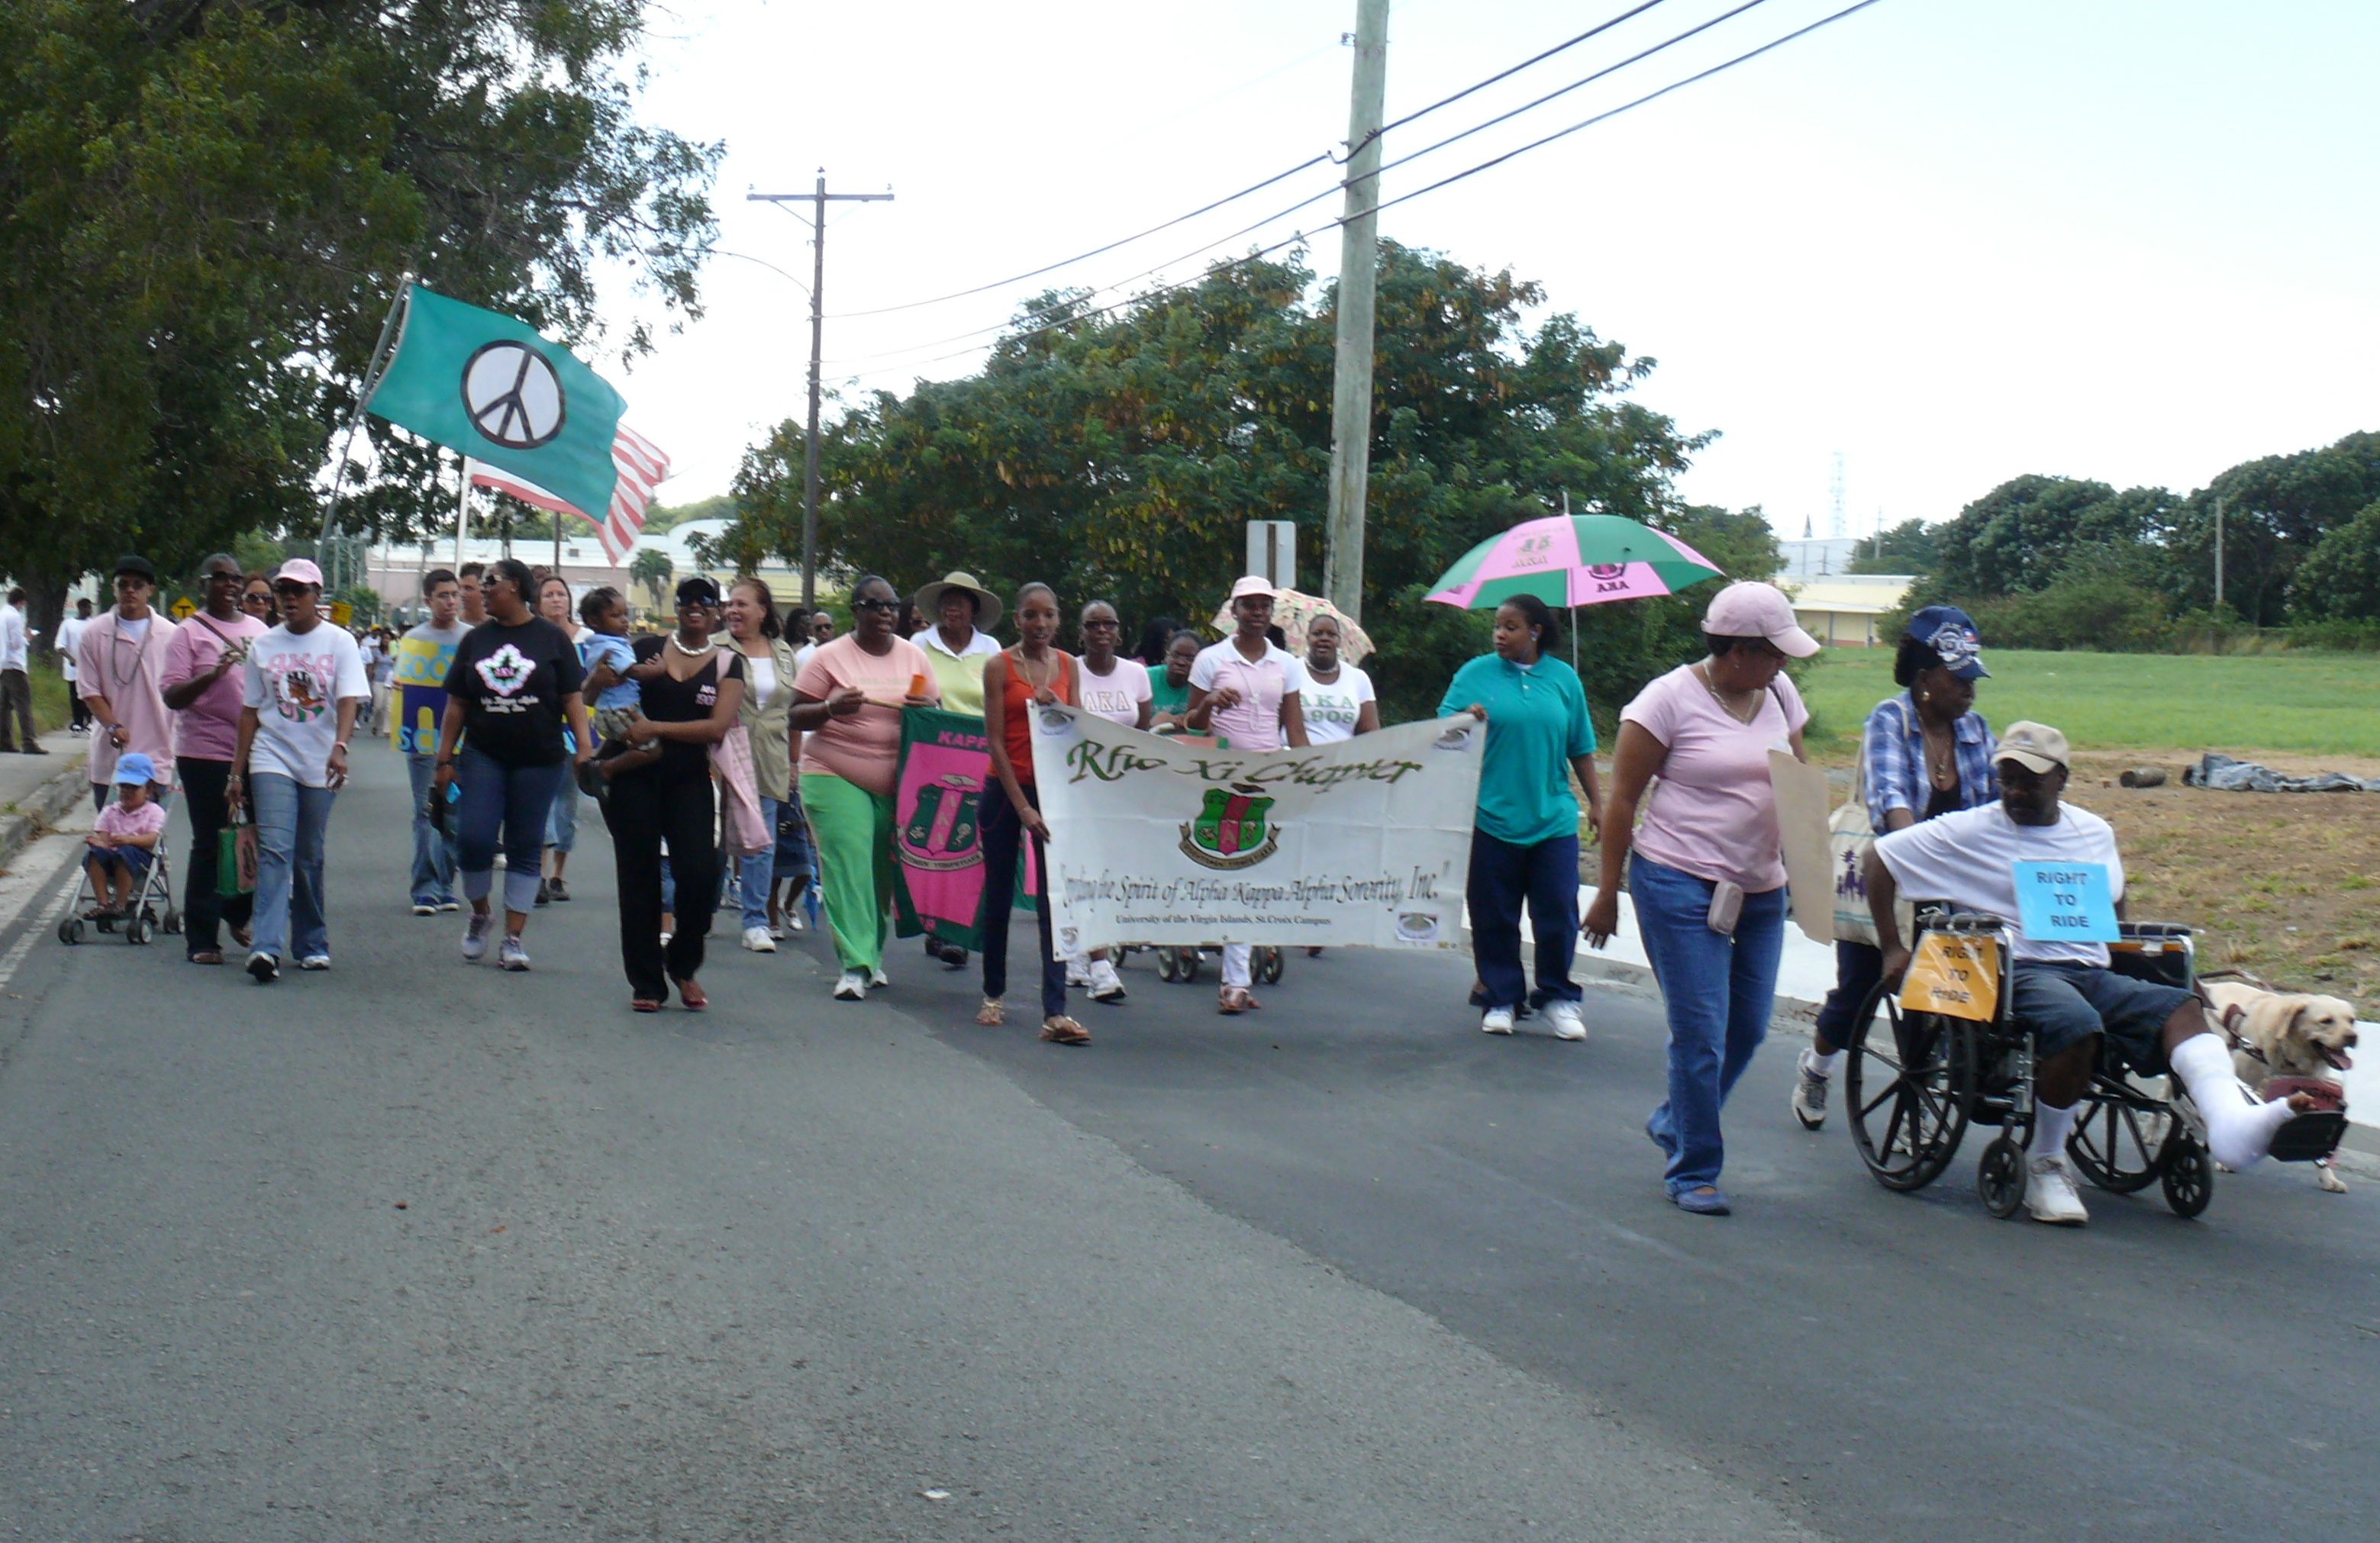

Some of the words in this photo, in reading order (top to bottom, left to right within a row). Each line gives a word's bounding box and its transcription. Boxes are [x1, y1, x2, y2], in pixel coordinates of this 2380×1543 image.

[1084, 691, 1130, 712] AKA
[1066, 739, 1169, 784] Rho
[1172, 759, 1244, 781] Xi
[2036, 871, 2088, 885] RIGHT
[1161, 878, 1184, 909] of
[1231, 881, 1285, 910] Kappa
[2053, 894, 2077, 907] TO
[1115, 914, 1159, 925] University
[1189, 914, 1218, 925] Virgin
[2051, 915, 2090, 928] RIDE
